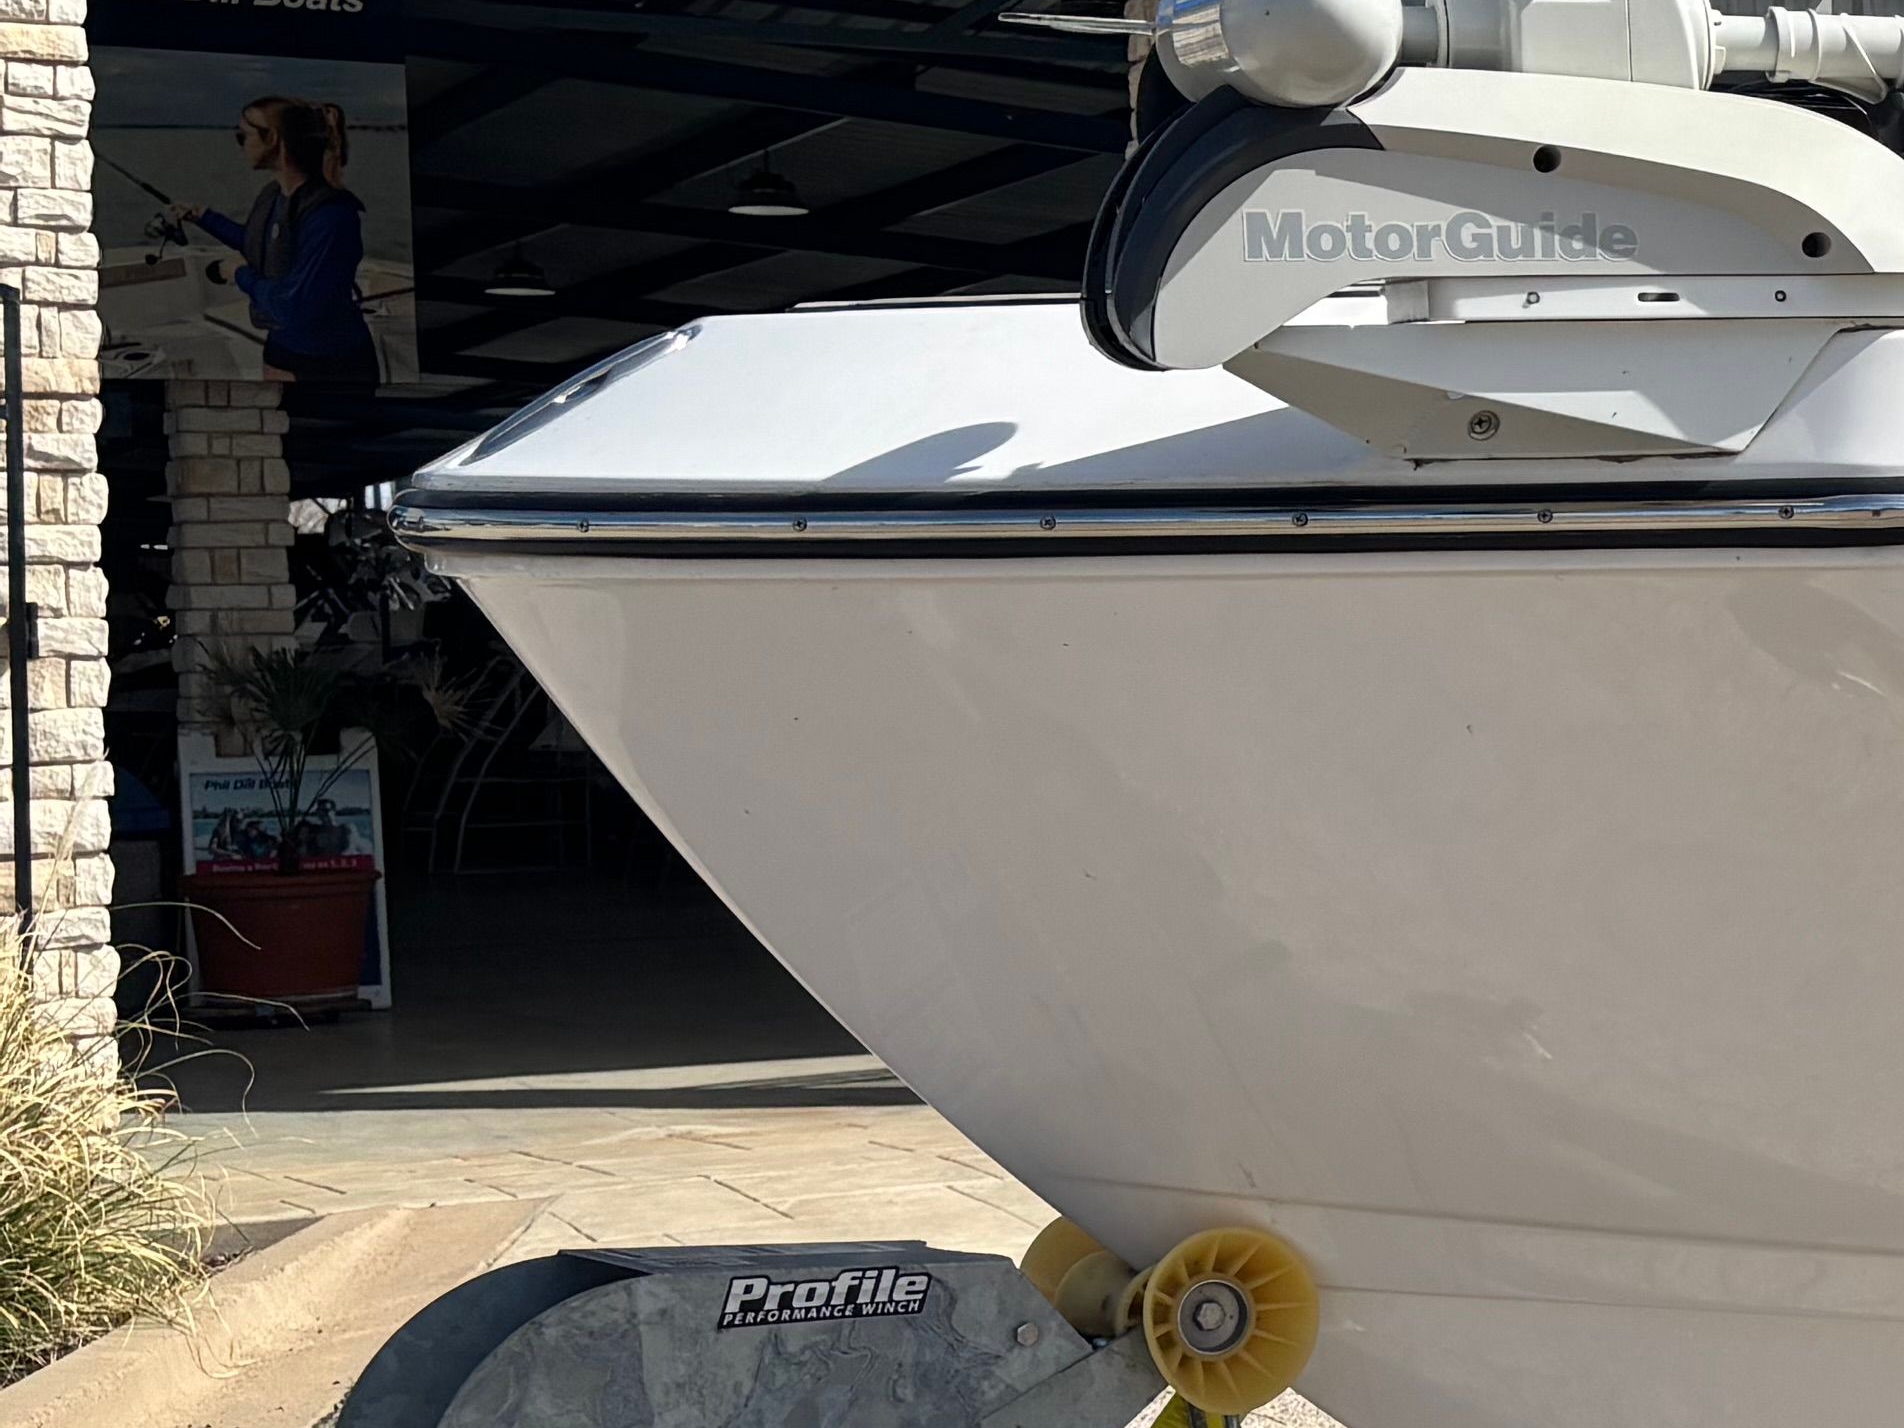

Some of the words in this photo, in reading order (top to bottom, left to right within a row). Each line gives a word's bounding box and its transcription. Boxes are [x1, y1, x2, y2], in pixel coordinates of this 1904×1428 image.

[1243, 208, 1640, 262] MotorGuide
[722, 1304, 854, 1326] PERFORMANCE
[861, 1300, 920, 1314] WINCH
[724, 1268, 929, 1313] Profile
